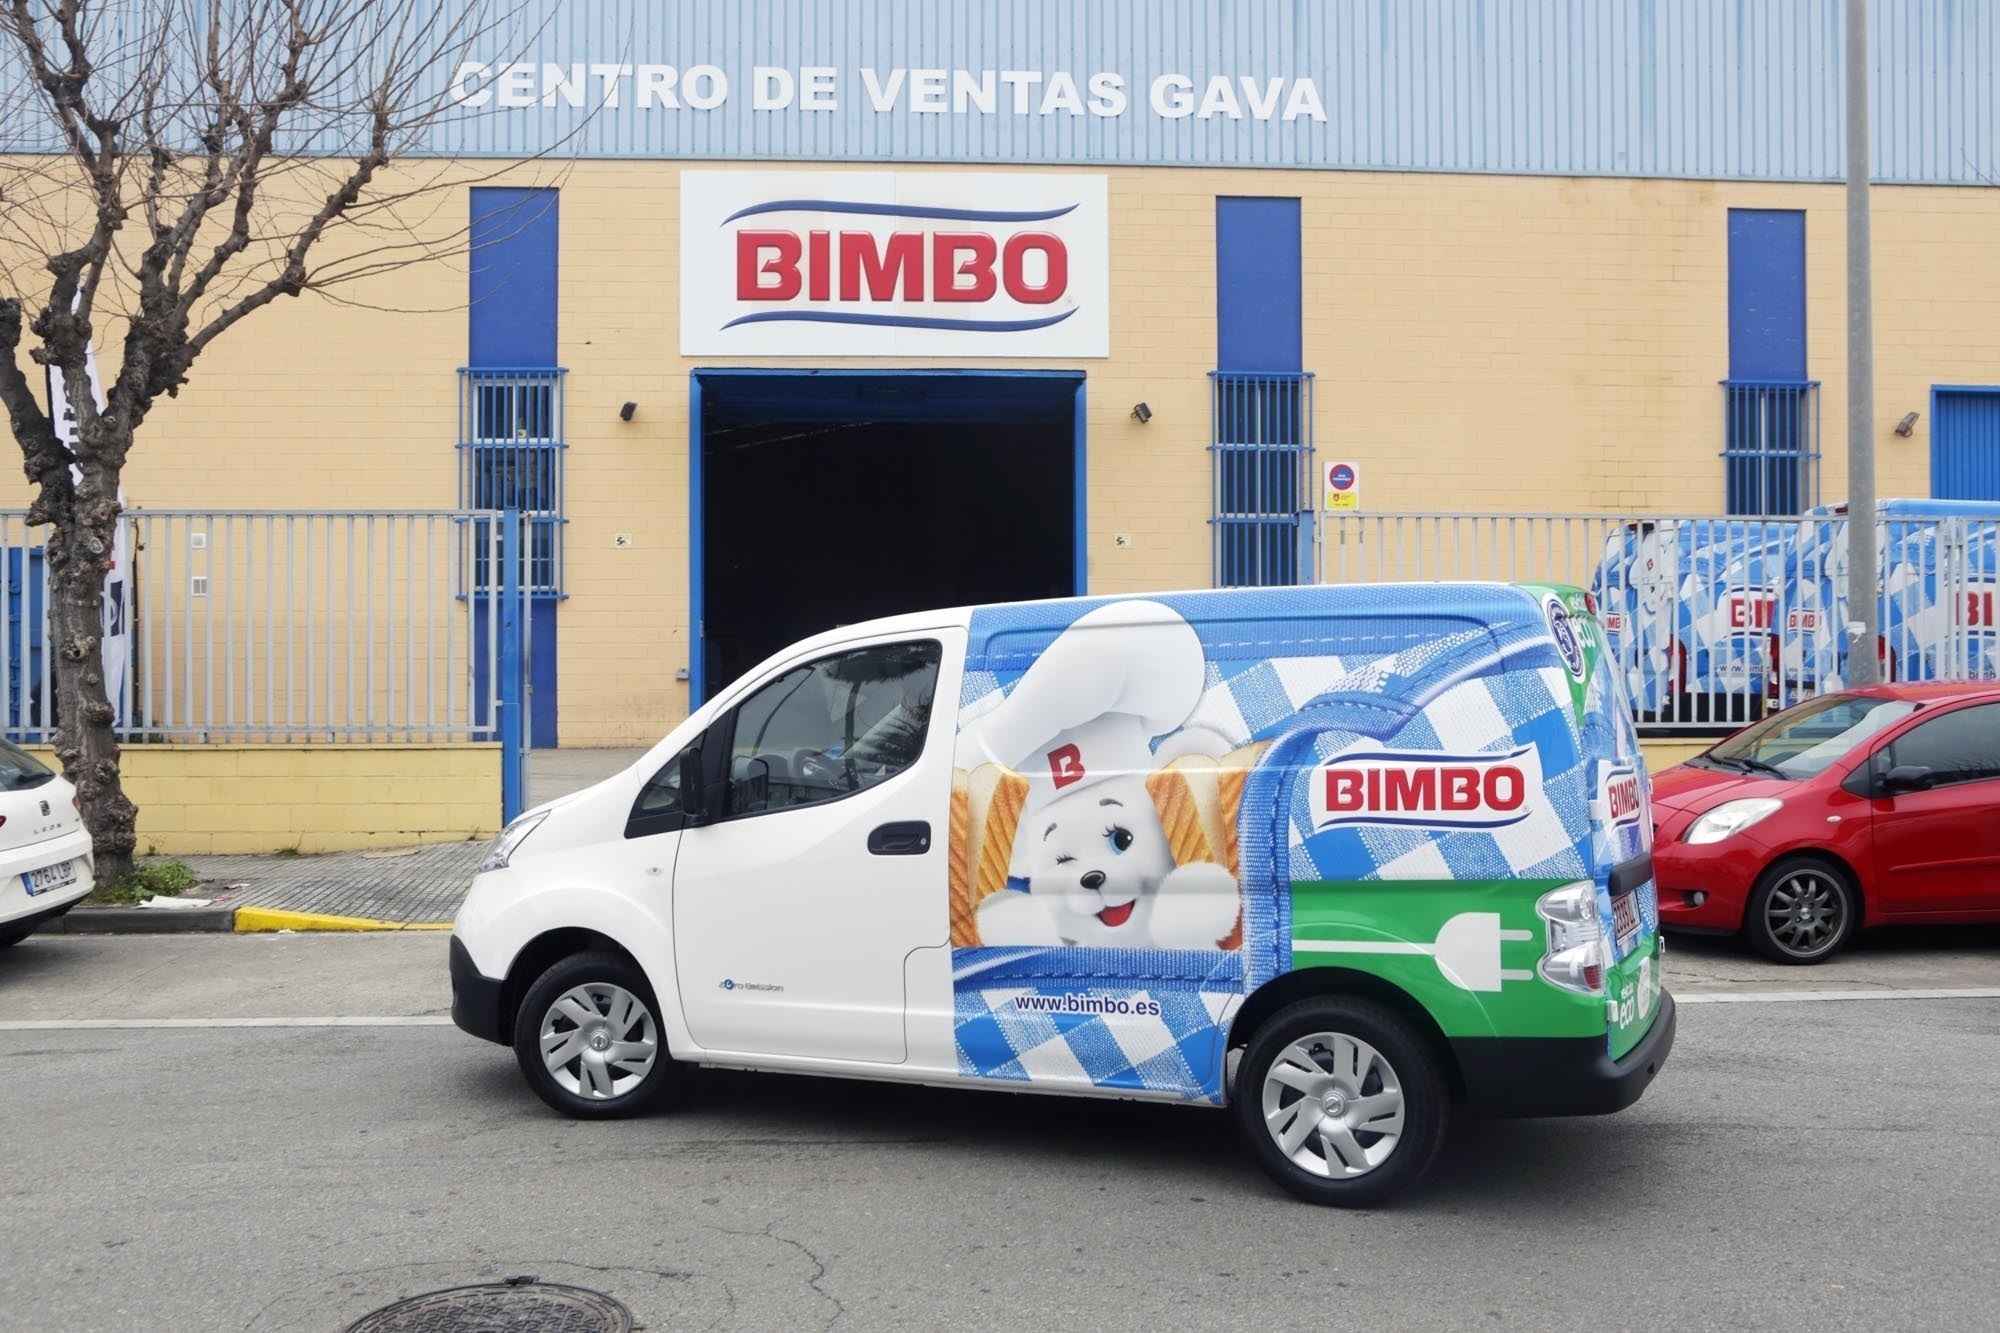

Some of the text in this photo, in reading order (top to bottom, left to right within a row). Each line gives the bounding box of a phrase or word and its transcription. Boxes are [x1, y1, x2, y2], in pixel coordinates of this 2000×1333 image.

[451, 61, 1328, 122] CENTRO DE VENTAS GAVA
[736, 229, 1069, 304] BIMBO
[1047, 743, 1086, 790] B
[1326, 764, 1525, 812] BIMBO
[1608, 776, 1640, 819] BIMBO
[1015, 994, 1160, 1016] www.bimbo.es
